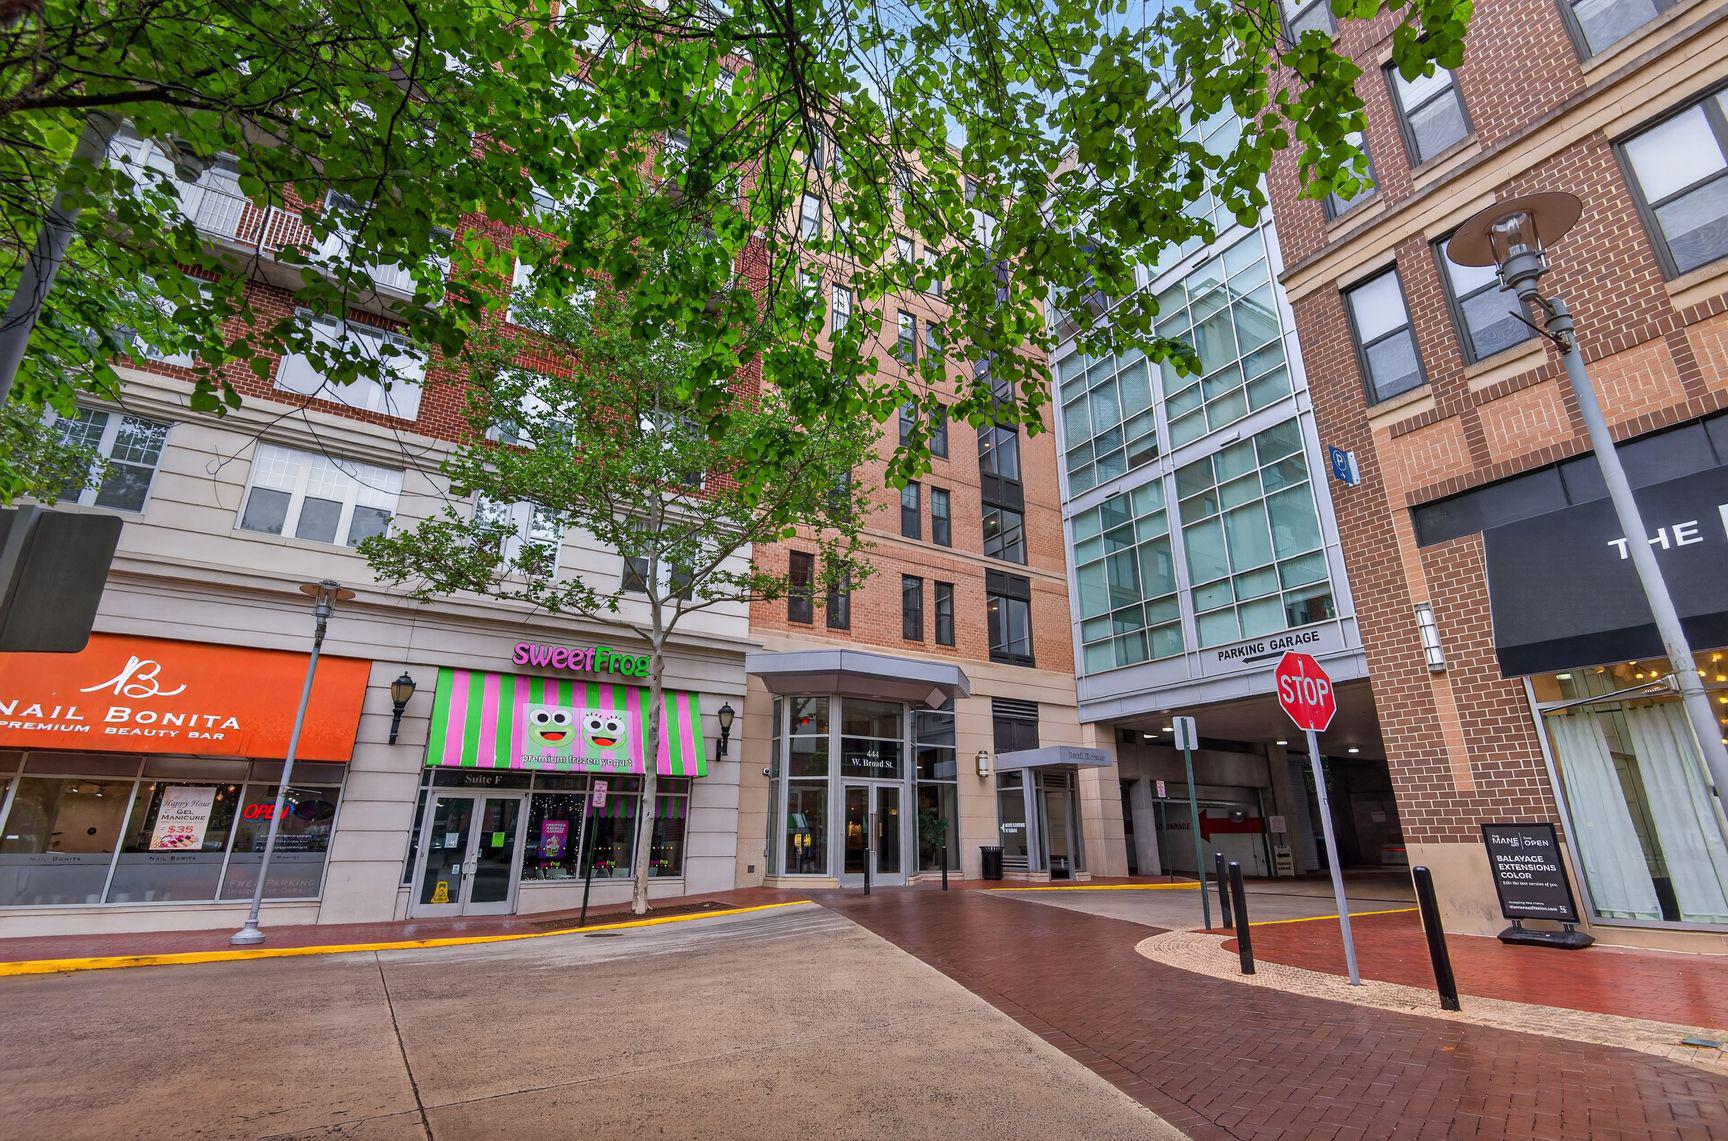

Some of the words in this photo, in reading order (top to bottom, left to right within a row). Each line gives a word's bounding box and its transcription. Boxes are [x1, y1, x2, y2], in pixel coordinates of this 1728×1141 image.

[1218, 643, 1265, 661] PARKING
[1269, 631, 1320, 650] GARAGE
[512, 642, 652, 678] sweetFrog
[1280, 674, 1329, 707] STOP
[0, 700, 85, 721] NAIL
[104, 706, 240, 730] BONITA
[0, 720, 91, 733] PREMIUM
[105, 727, 180, 738] BEAUTY
[188, 731, 225, 741] BAR
[866, 750, 879, 758] 444
[521, 754, 567, 764] premium
[568, 755, 600, 766] frozen
[600, 758, 633, 769] yogurt
[852, 758, 861, 767] W.
[863, 759, 884, 768] Broad
[465, 774, 492, 784] Suite
[494, 776, 503, 784] F
[168, 825, 194, 833] $35
[1496, 855, 1545, 863] BALAYAGE
[1498, 863, 1557, 871] EXTENSIONS
